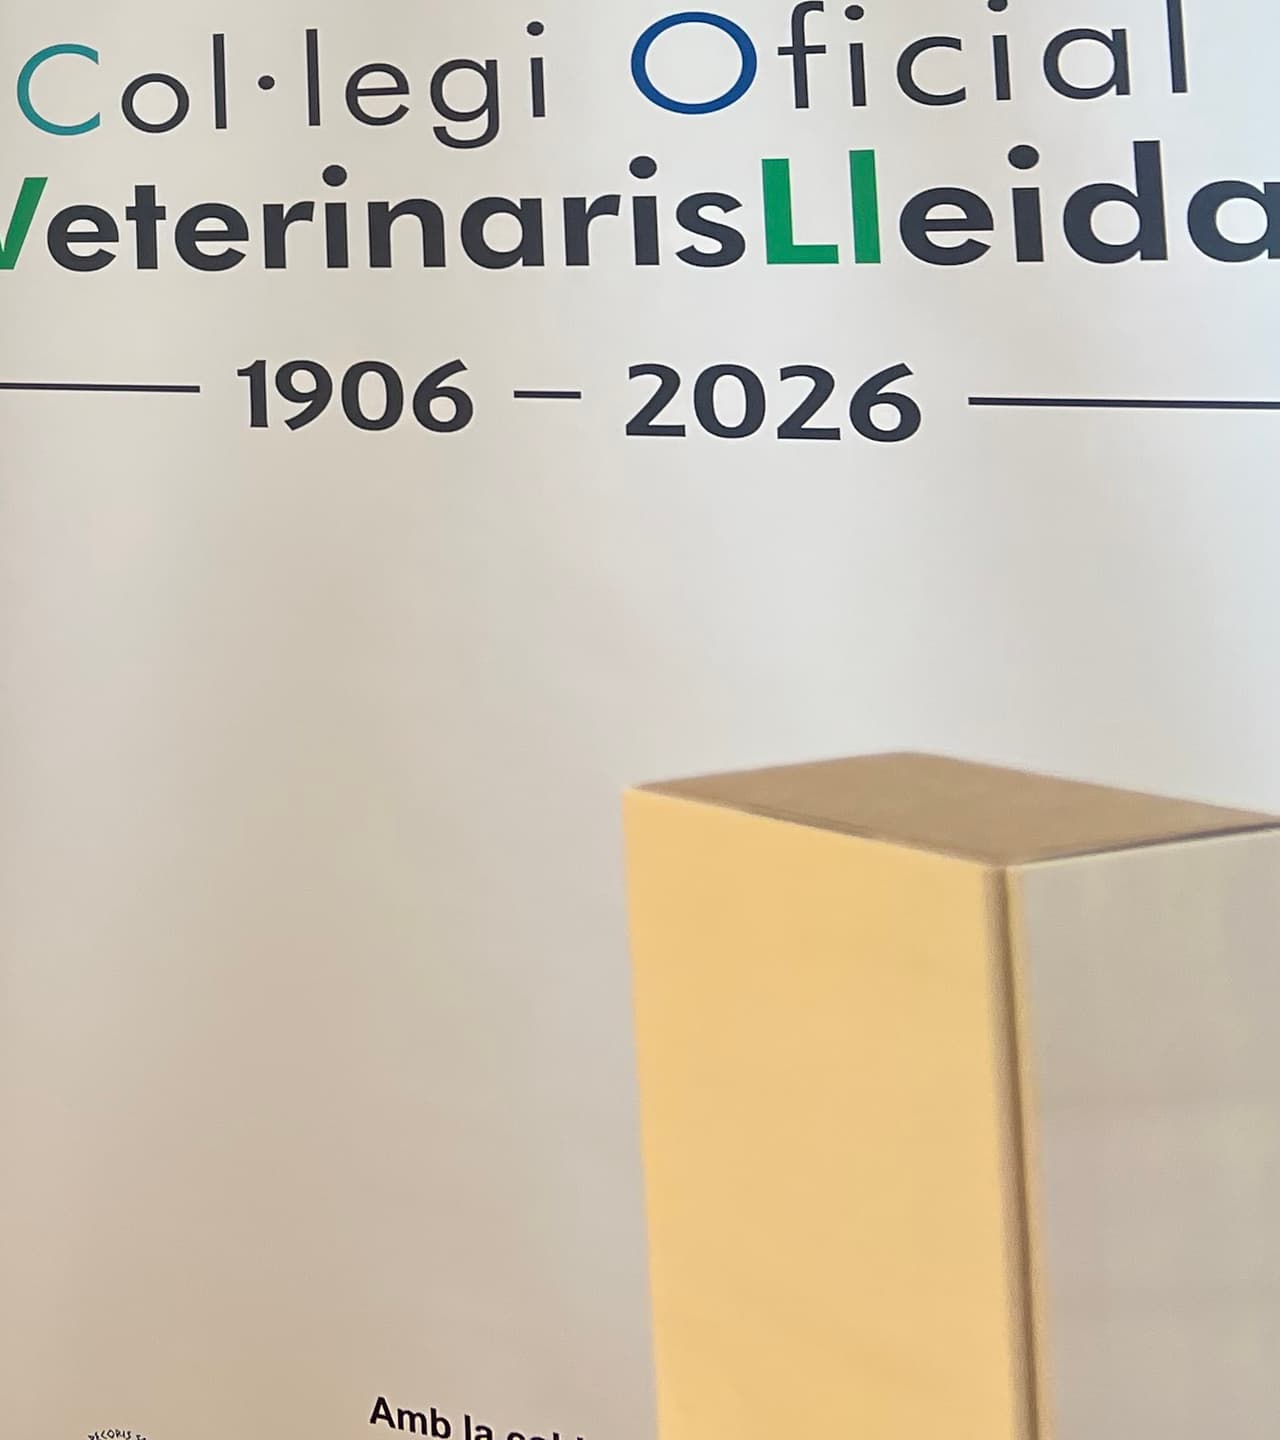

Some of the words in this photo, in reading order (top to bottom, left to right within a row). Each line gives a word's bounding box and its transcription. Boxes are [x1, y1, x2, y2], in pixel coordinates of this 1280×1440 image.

[16, 20, 546, 149] Col·legi
[237, 358, 474, 433] 1906
[625, 361, 923, 443] 2026
[369, 1396, 451, 1439] Amb
